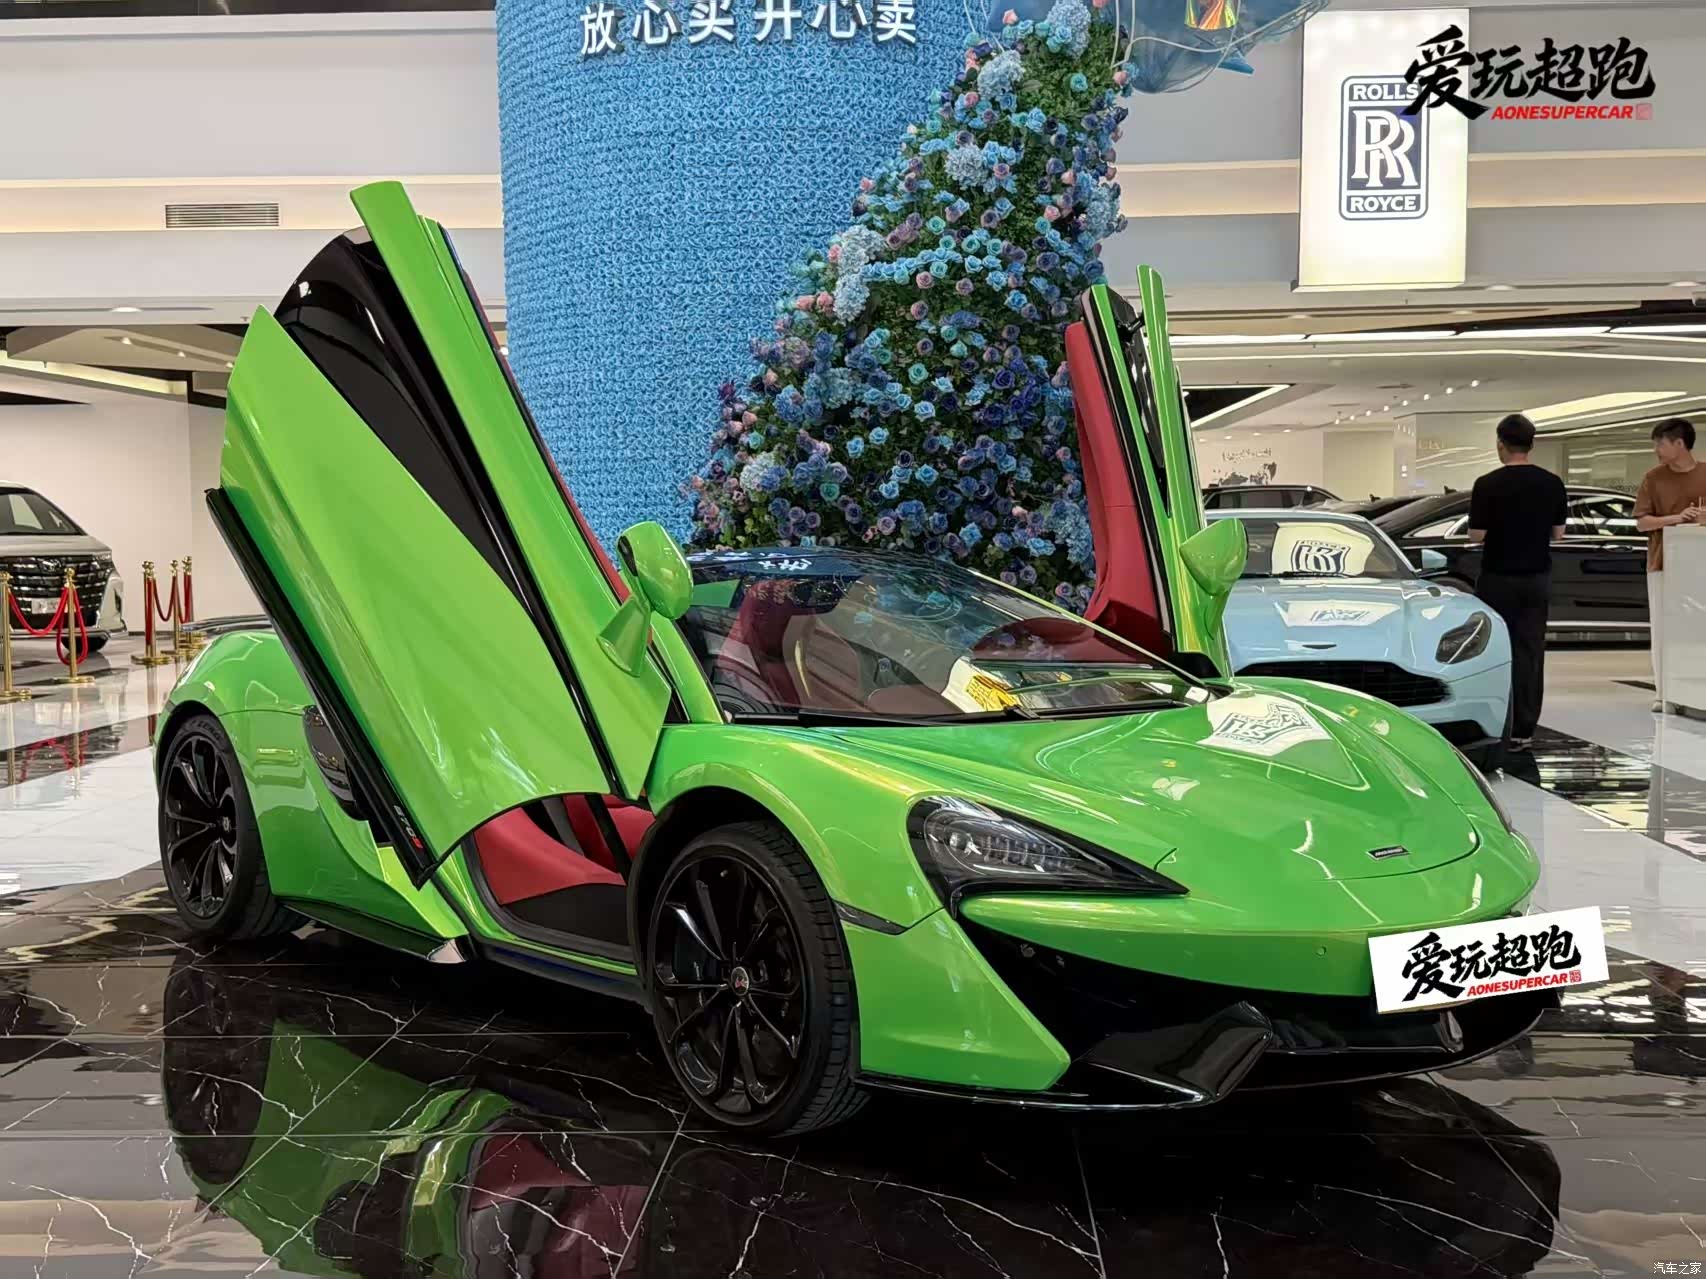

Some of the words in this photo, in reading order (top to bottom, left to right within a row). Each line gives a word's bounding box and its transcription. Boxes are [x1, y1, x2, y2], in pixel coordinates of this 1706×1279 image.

[579, 0, 917, 55] 放心买开心卖
[1352, 84, 1419, 101] ROLLS
[1351, 109, 1418, 187] RR
[1350, 195, 1417, 213] ROYCE
